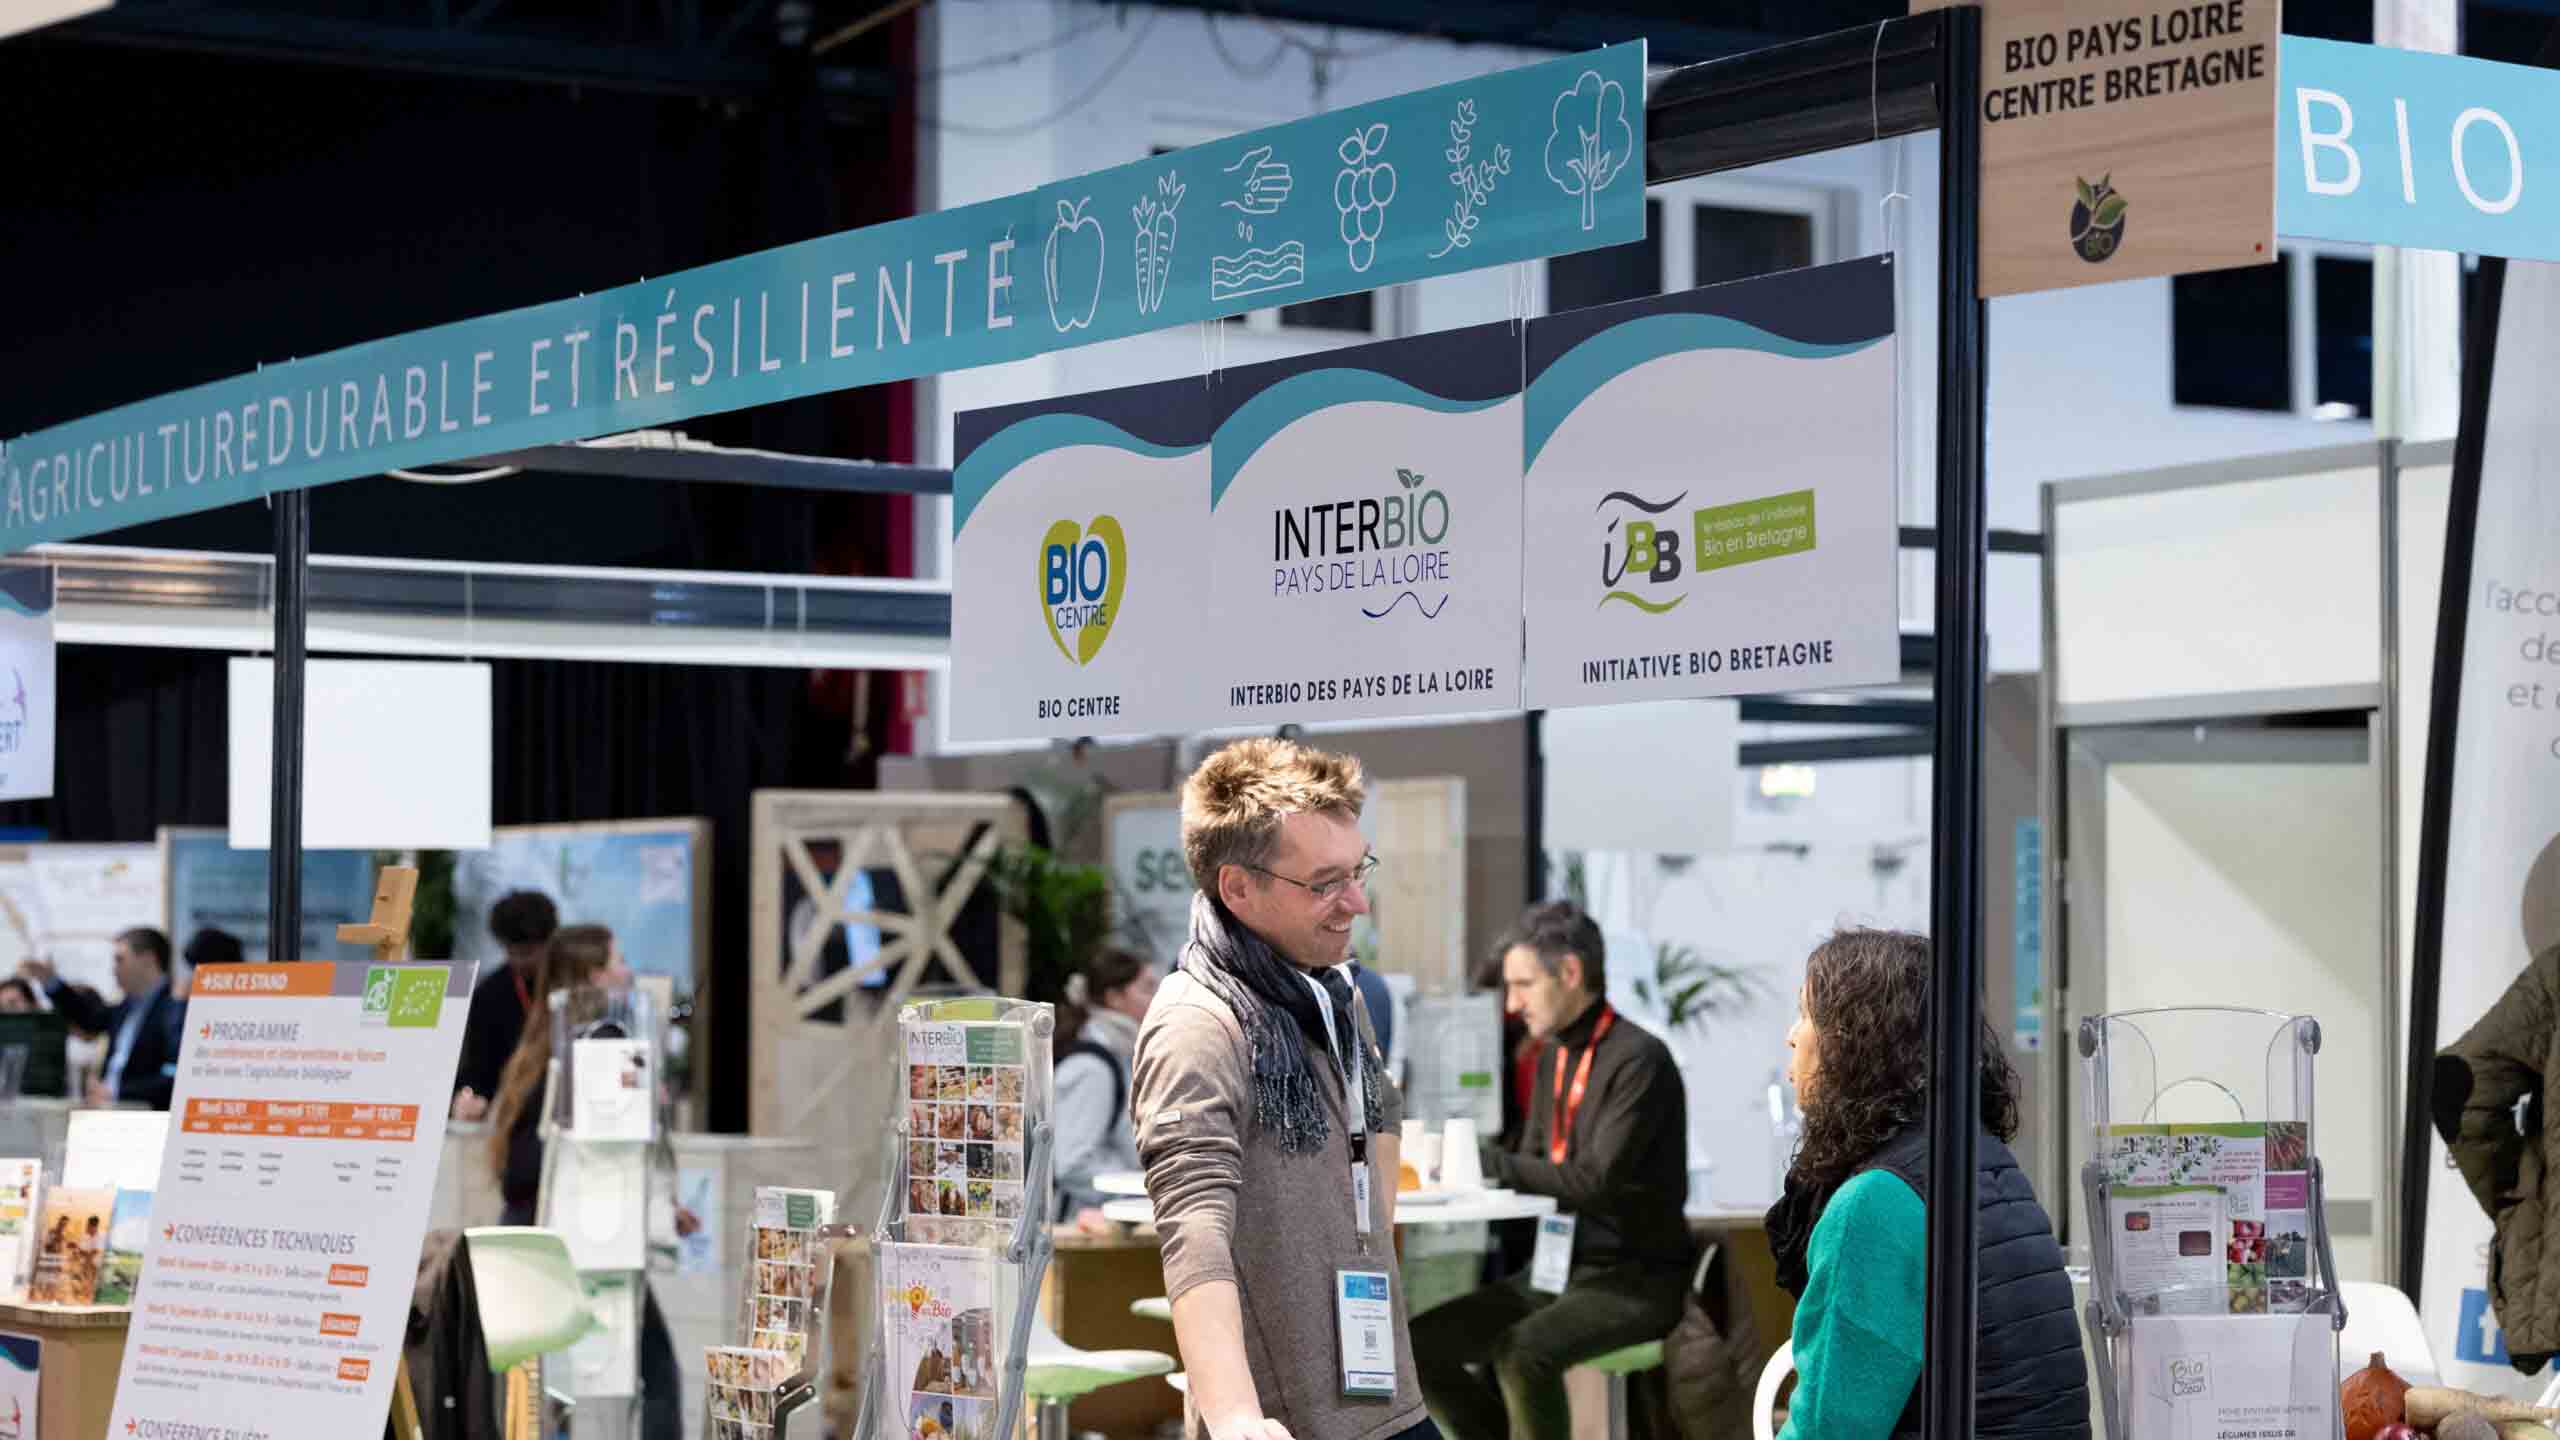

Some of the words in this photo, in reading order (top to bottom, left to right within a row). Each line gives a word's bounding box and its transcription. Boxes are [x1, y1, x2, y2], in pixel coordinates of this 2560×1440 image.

[2004, 34, 2058, 73] BIO
[2068, 18, 2141, 63] PAYS
[2152, 0, 2244, 46] LOIRE
[1984, 75, 2095, 123] CENTRE
[2105, 44, 2265, 103] BRETAGNE
[2296, 87, 2523, 215] BIO
[530, 331, 591, 415] ET
[1275, 489, 1449, 561] INTERBIO
[1047, 540, 1107, 606] BIO
[1275, 564, 1325, 596] PAYS
[1331, 560, 1355, 591] DE
[1362, 557, 1386, 588] LA
[1392, 551, 1449, 584] LOIRE
[1056, 603, 1107, 630] CENTRE
[2485, 579, 2560, 616] l'acc
[1583, 654, 1681, 684] INITIATIVE
[1690, 650, 1722, 675] BIO
[1730, 640, 1833, 672] BRETAGNE
[1038, 699, 1062, 718] BIO
[1068, 696, 1120, 717] CENTRE
[1231, 680, 1301, 706] INTERBIO
[1307, 678, 1337, 702] DES
[1344, 675, 1385, 699] PAYS
[1391, 674, 1412, 696] DE
[1419, 671, 1439, 694] LA
[1445, 668, 1494, 692] LOIRE
[2507, 682, 2543, 710] et
[1136, 847, 1192, 891] se
[211, 1022, 300, 1041] PROGRAMME
